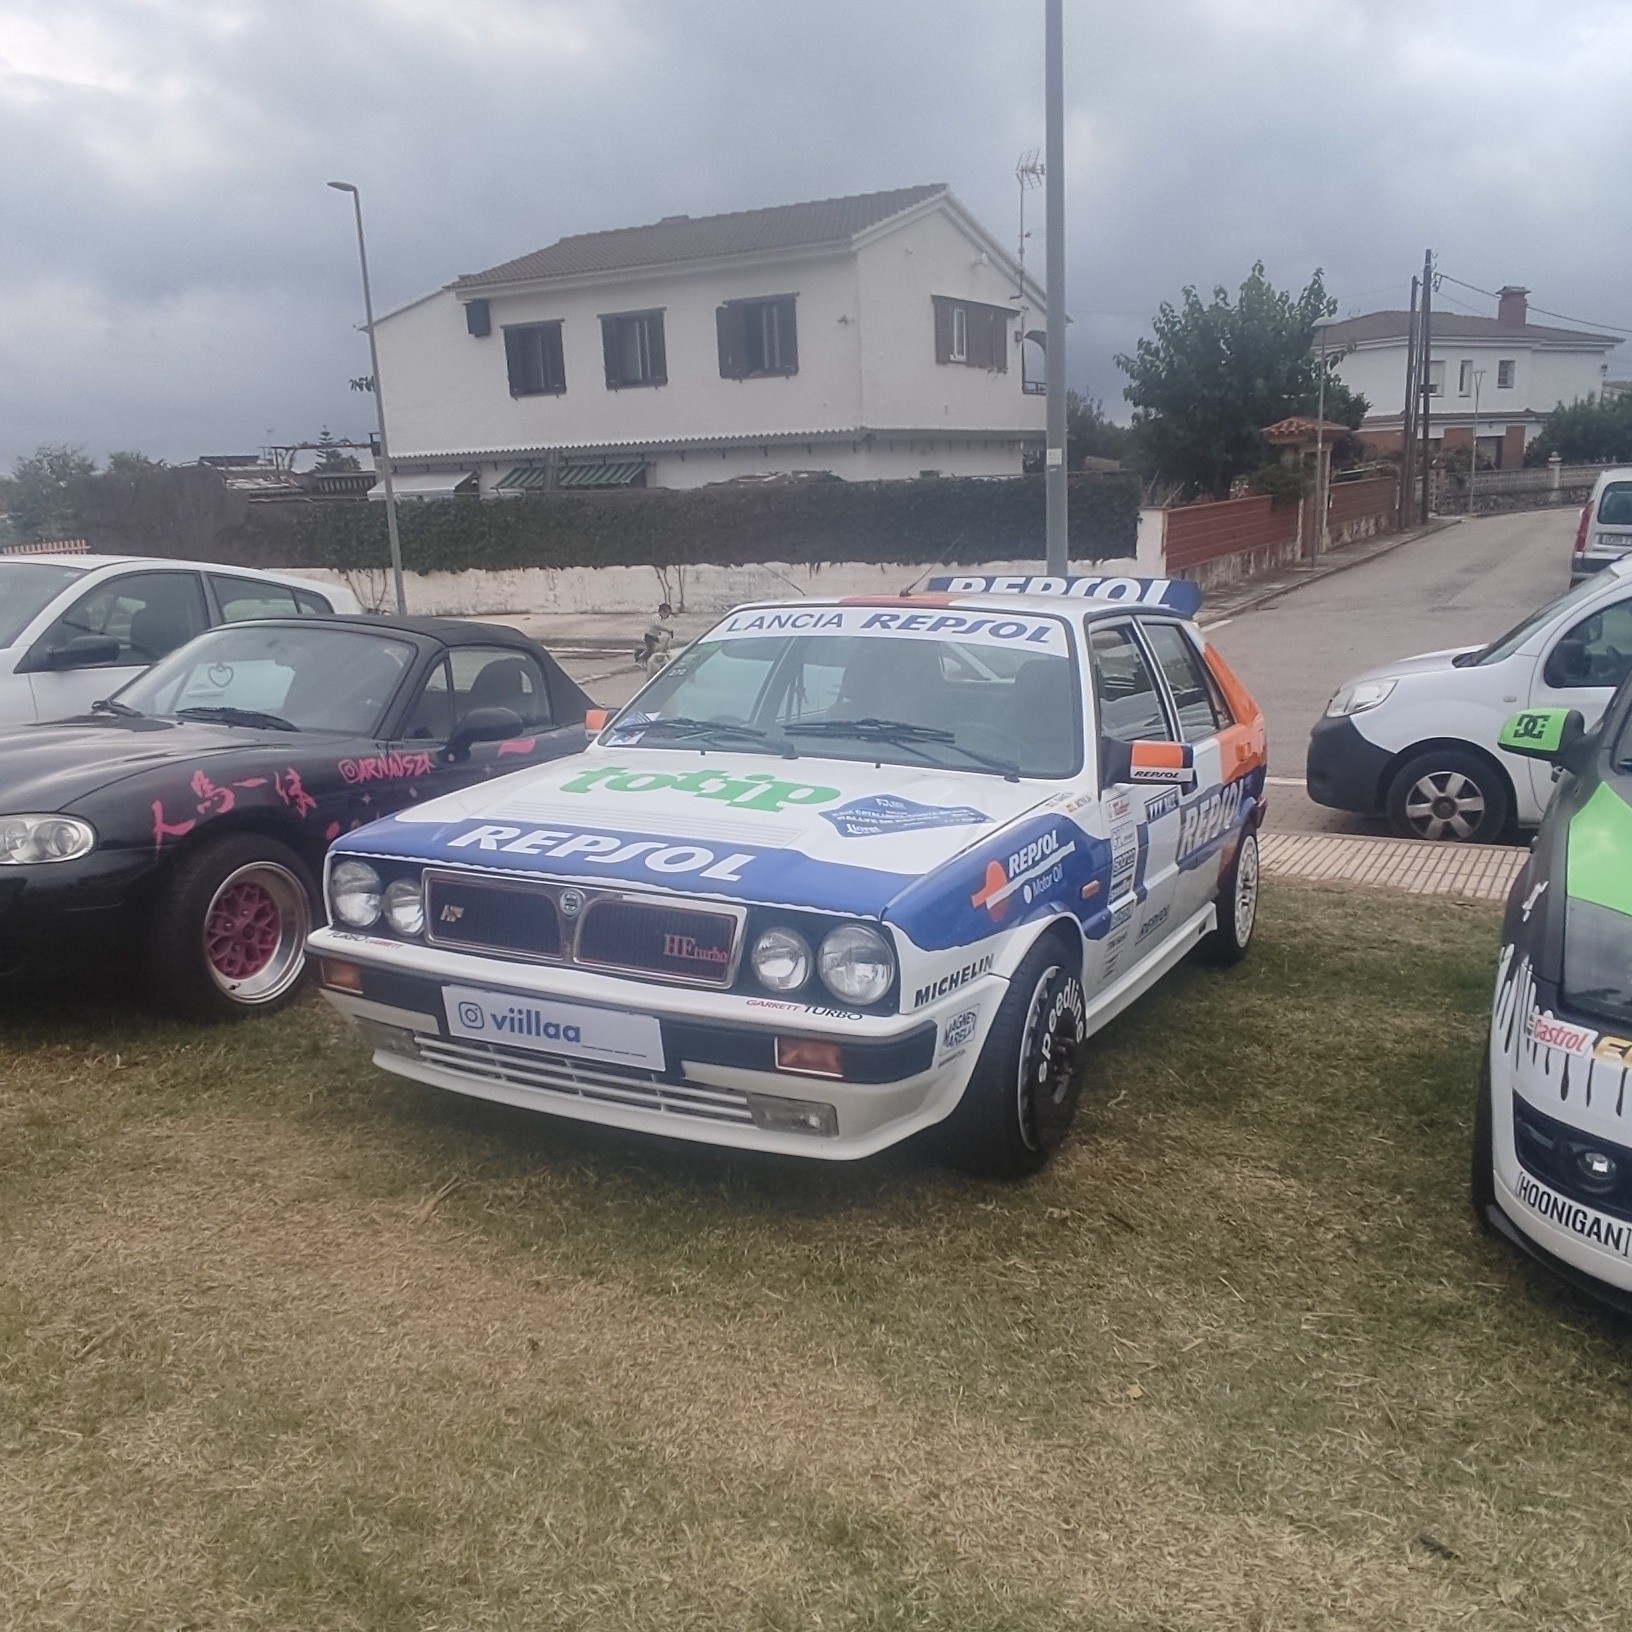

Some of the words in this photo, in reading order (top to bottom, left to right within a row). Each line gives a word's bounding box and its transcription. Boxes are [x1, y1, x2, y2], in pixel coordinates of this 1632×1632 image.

[725, 612, 844, 633] LANCIA
[860, 612, 1055, 645] REPSOL
[558, 766, 842, 813] totip
[1134, 770, 1180, 779] REPSOL
[447, 824, 756, 882] REPSOL
[1009, 829, 1059, 877] REPSOL
[1031, 875, 1053, 897] Motor
[914, 953, 994, 1007] MICHELIN
[746, 998, 802, 1012] GARRETT
[804, 1005, 864, 1021] TURBO
[1534, 1019, 1588, 1052] Castrol
